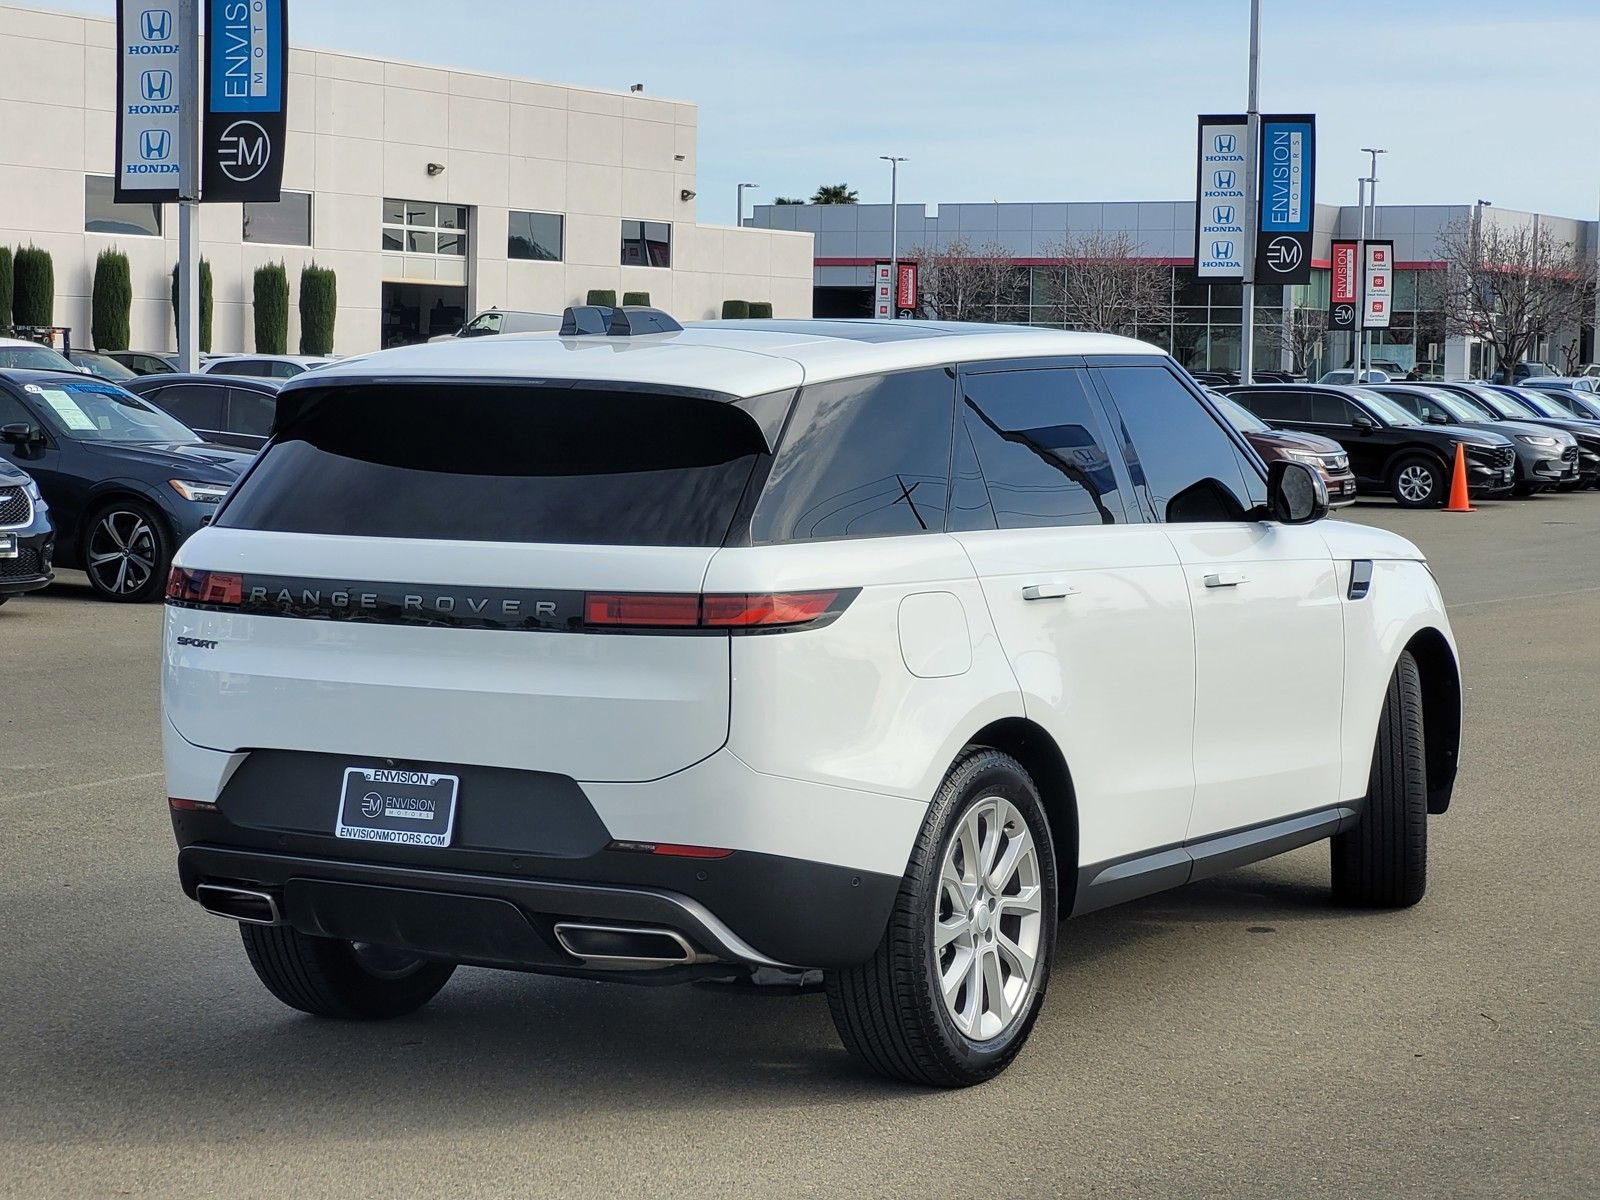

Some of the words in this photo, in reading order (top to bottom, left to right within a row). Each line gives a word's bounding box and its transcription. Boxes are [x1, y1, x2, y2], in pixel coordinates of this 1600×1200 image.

[126, 164, 180, 174] HONDA
[1271, 131, 1289, 223] ENVISION
[1291, 140, 1300, 216] MOTORS
[1337, 248, 1347, 298] ENVISION
[901, 267, 909, 305] ENVISION
[250, 586, 378, 608] RANGE
[404, 594, 557, 617] ROVER
[177, 636, 218, 649] SPORT
[373, 770, 429, 785] ENVISION
[385, 796, 436, 811] ENVISION
[340, 827, 446, 846] ENVISIONMOTORS.COM
